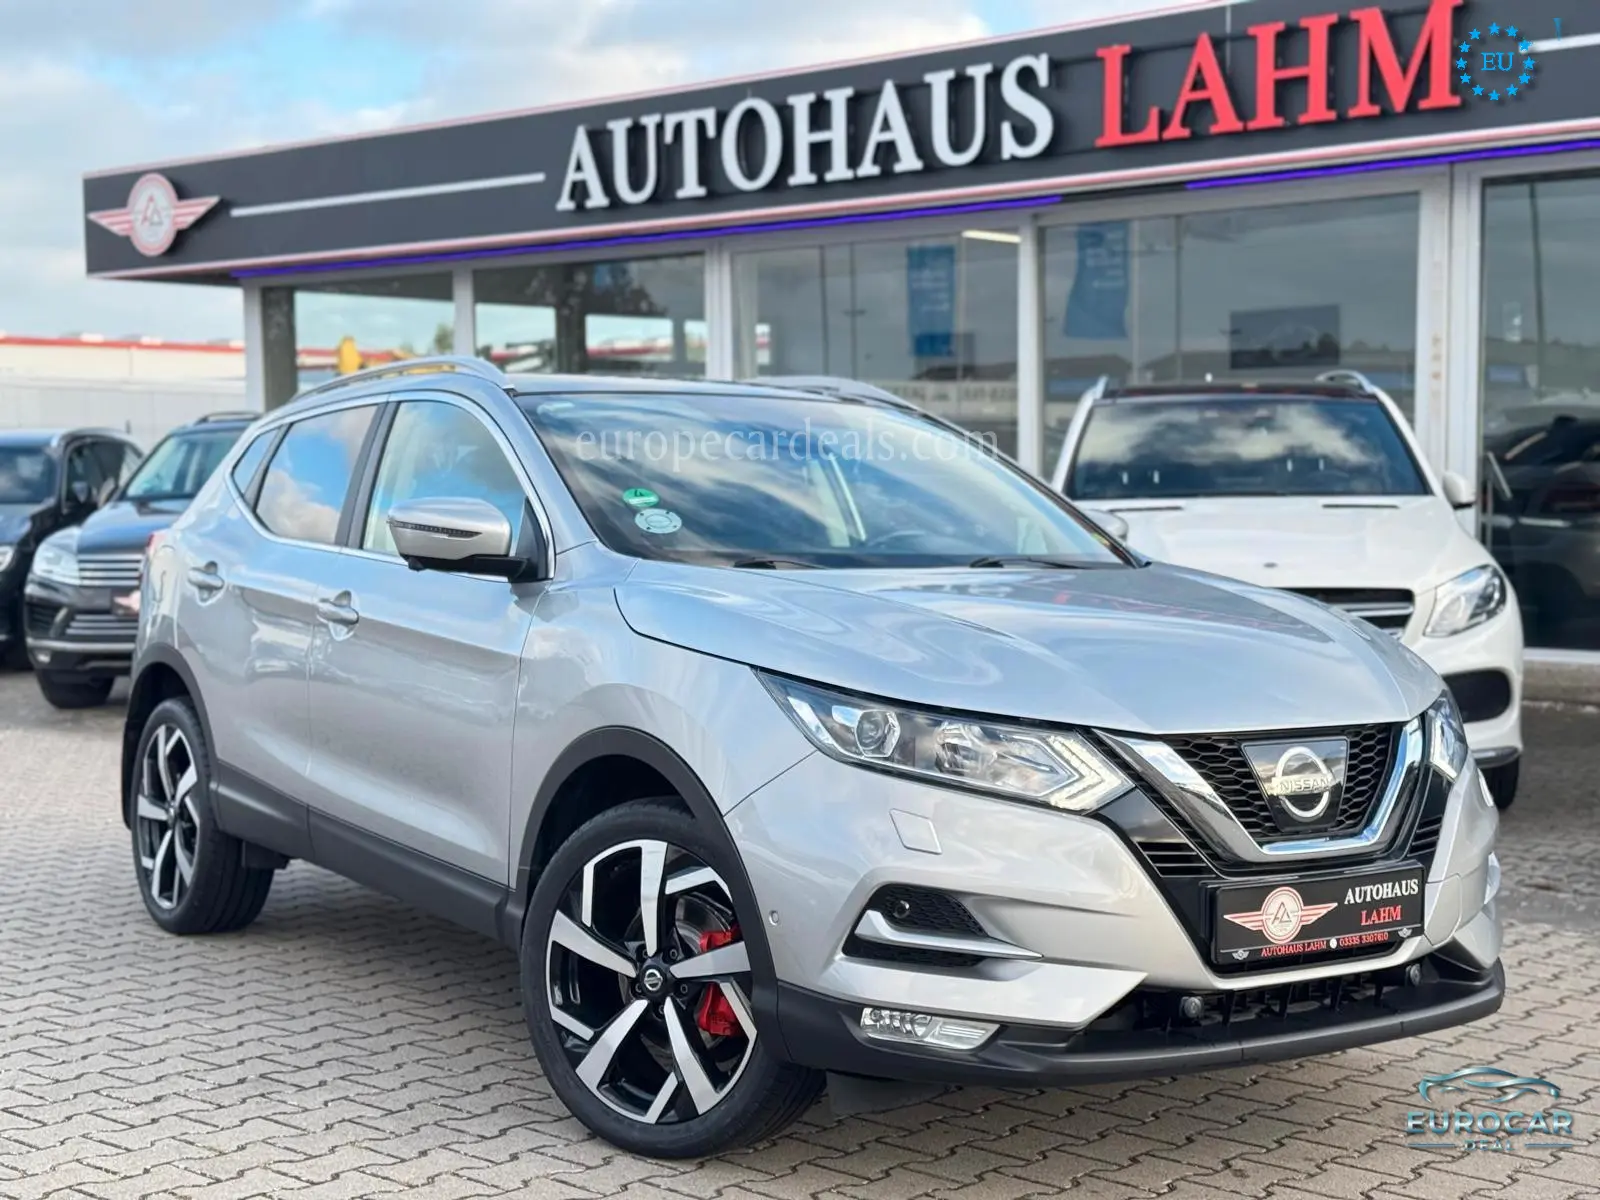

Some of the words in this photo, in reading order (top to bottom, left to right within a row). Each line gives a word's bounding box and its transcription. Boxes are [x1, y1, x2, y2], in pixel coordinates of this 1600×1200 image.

[556, 53, 1054, 211] AUTOHAUS
[1095, 0, 1465, 147] LAHM
[1279, 778, 1329, 793] NISSAN
[1344, 879, 1419, 904] AUTOHAUS
[1361, 905, 1401, 926] LAHM
[1261, 944, 1304, 957] AUTOHAUS
[1305, 940, 1327, 952] LAHM
